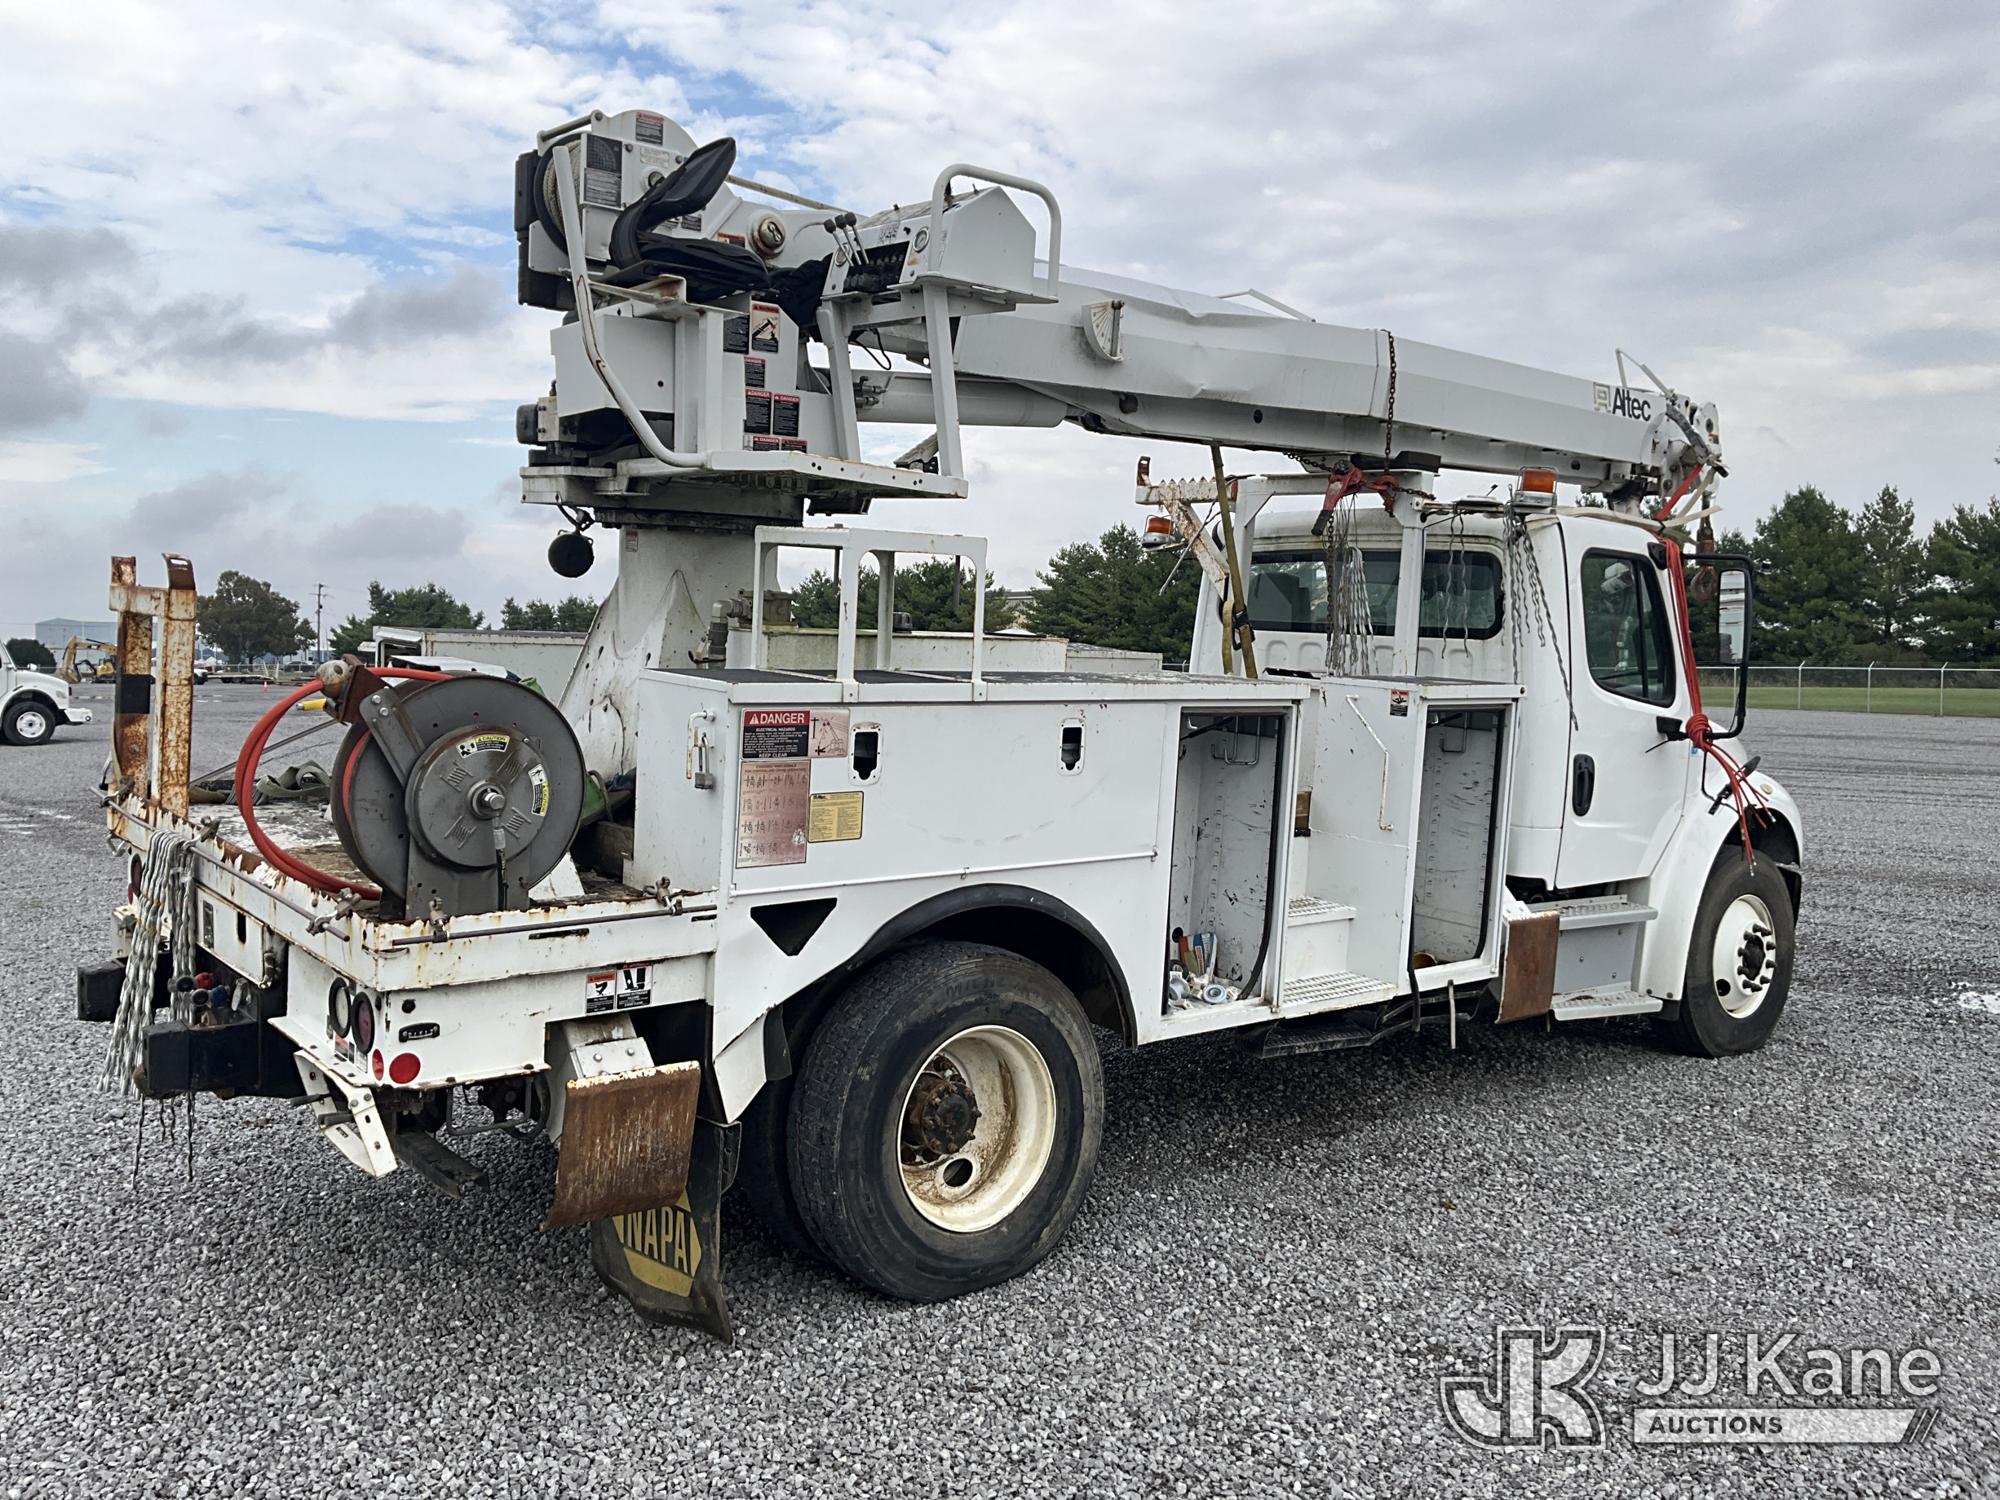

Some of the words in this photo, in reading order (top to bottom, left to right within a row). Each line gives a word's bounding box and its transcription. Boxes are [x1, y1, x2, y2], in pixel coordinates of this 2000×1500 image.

[1612, 387, 1651, 421] Altec
[760, 712, 806, 725] DANGER
[627, 1206, 689, 1274] NAPA
